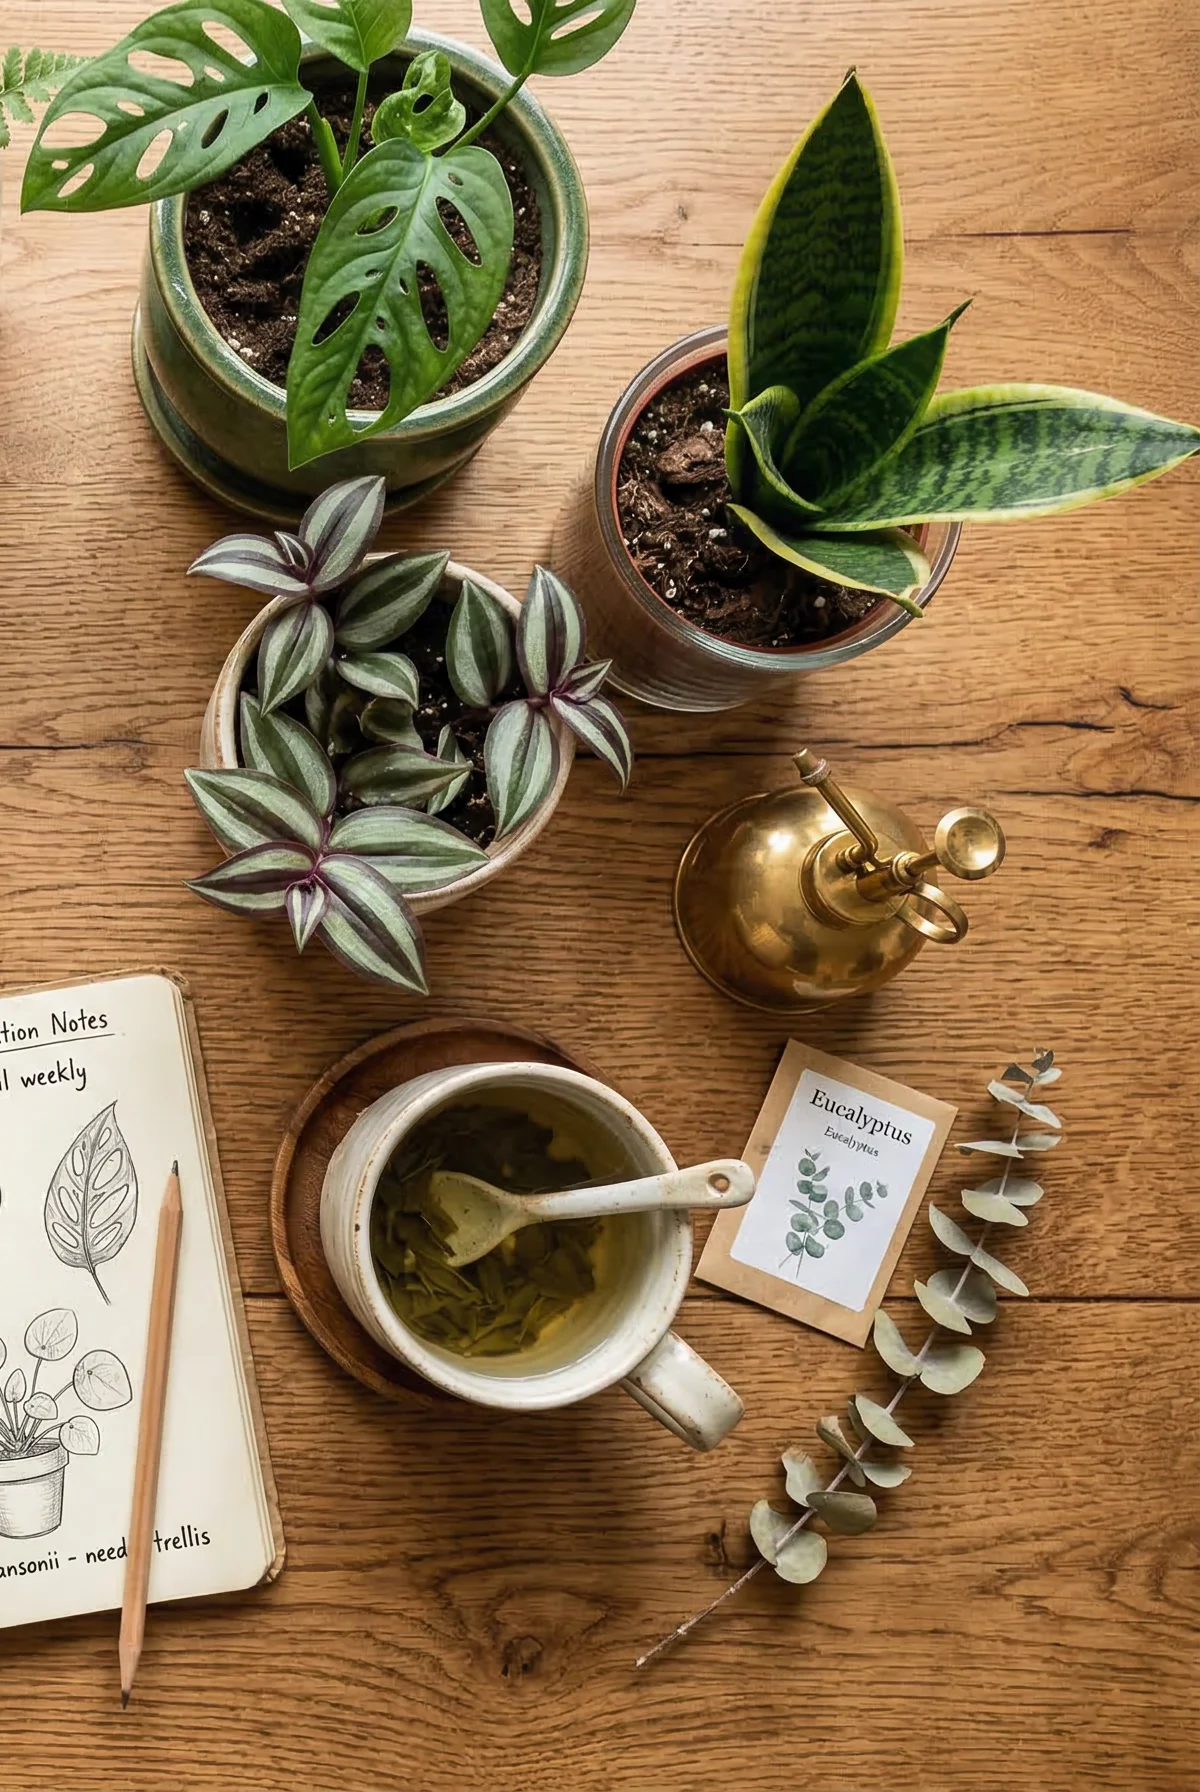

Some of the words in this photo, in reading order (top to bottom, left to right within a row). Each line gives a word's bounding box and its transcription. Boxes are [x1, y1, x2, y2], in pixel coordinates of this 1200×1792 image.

[51, 1008, 108, 1036] Notes
[20, 1057, 87, 1092] weekly
[809, 1088, 913, 1146] Eucalyptus
[85, 1536, 131, 1564] need
[153, 1524, 211, 1553] trellis
